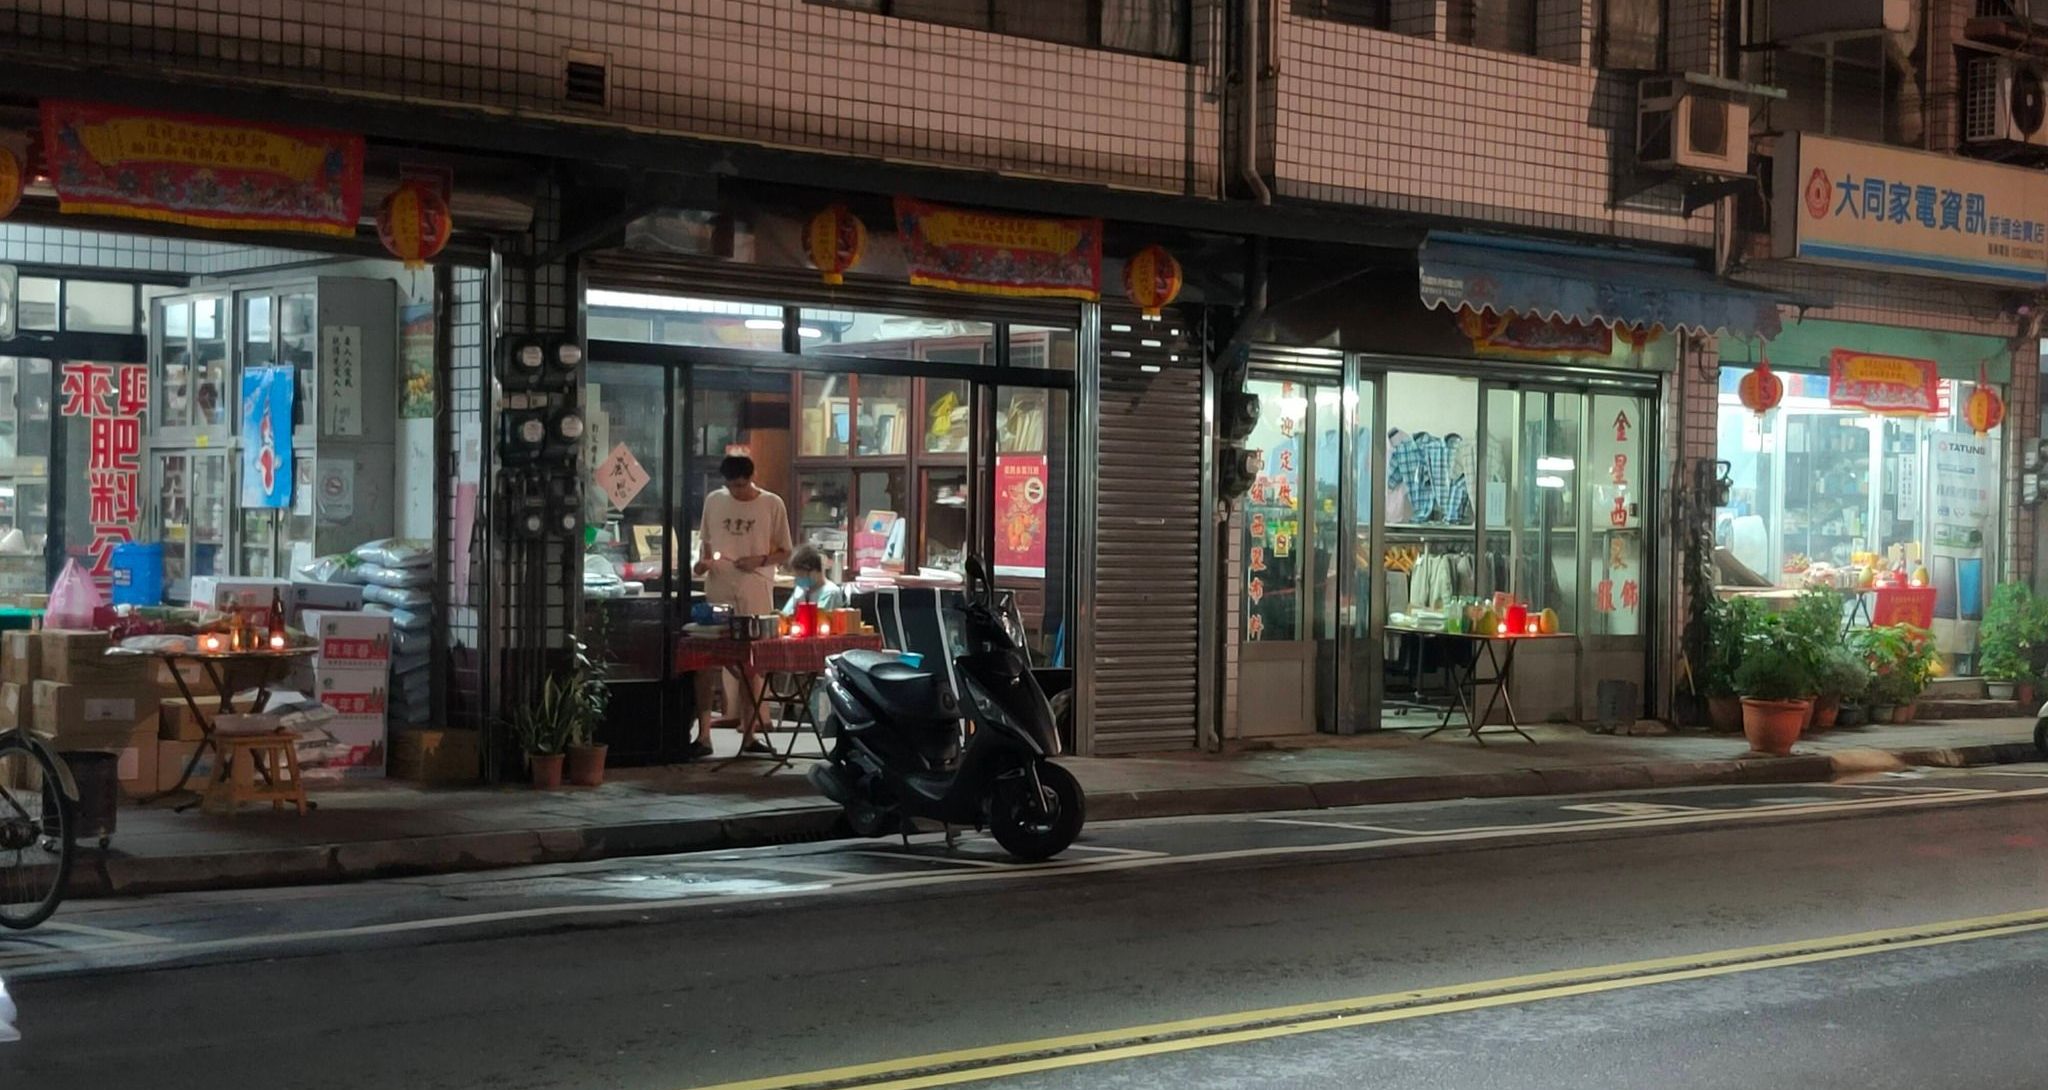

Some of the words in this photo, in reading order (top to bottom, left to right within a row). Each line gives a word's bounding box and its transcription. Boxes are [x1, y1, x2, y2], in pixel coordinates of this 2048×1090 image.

[1834, 173, 1986, 235] 大同家電資訊
[1949, 442, 1986, 456] TATUNG
[88, 417, 141, 603] 肥料公
